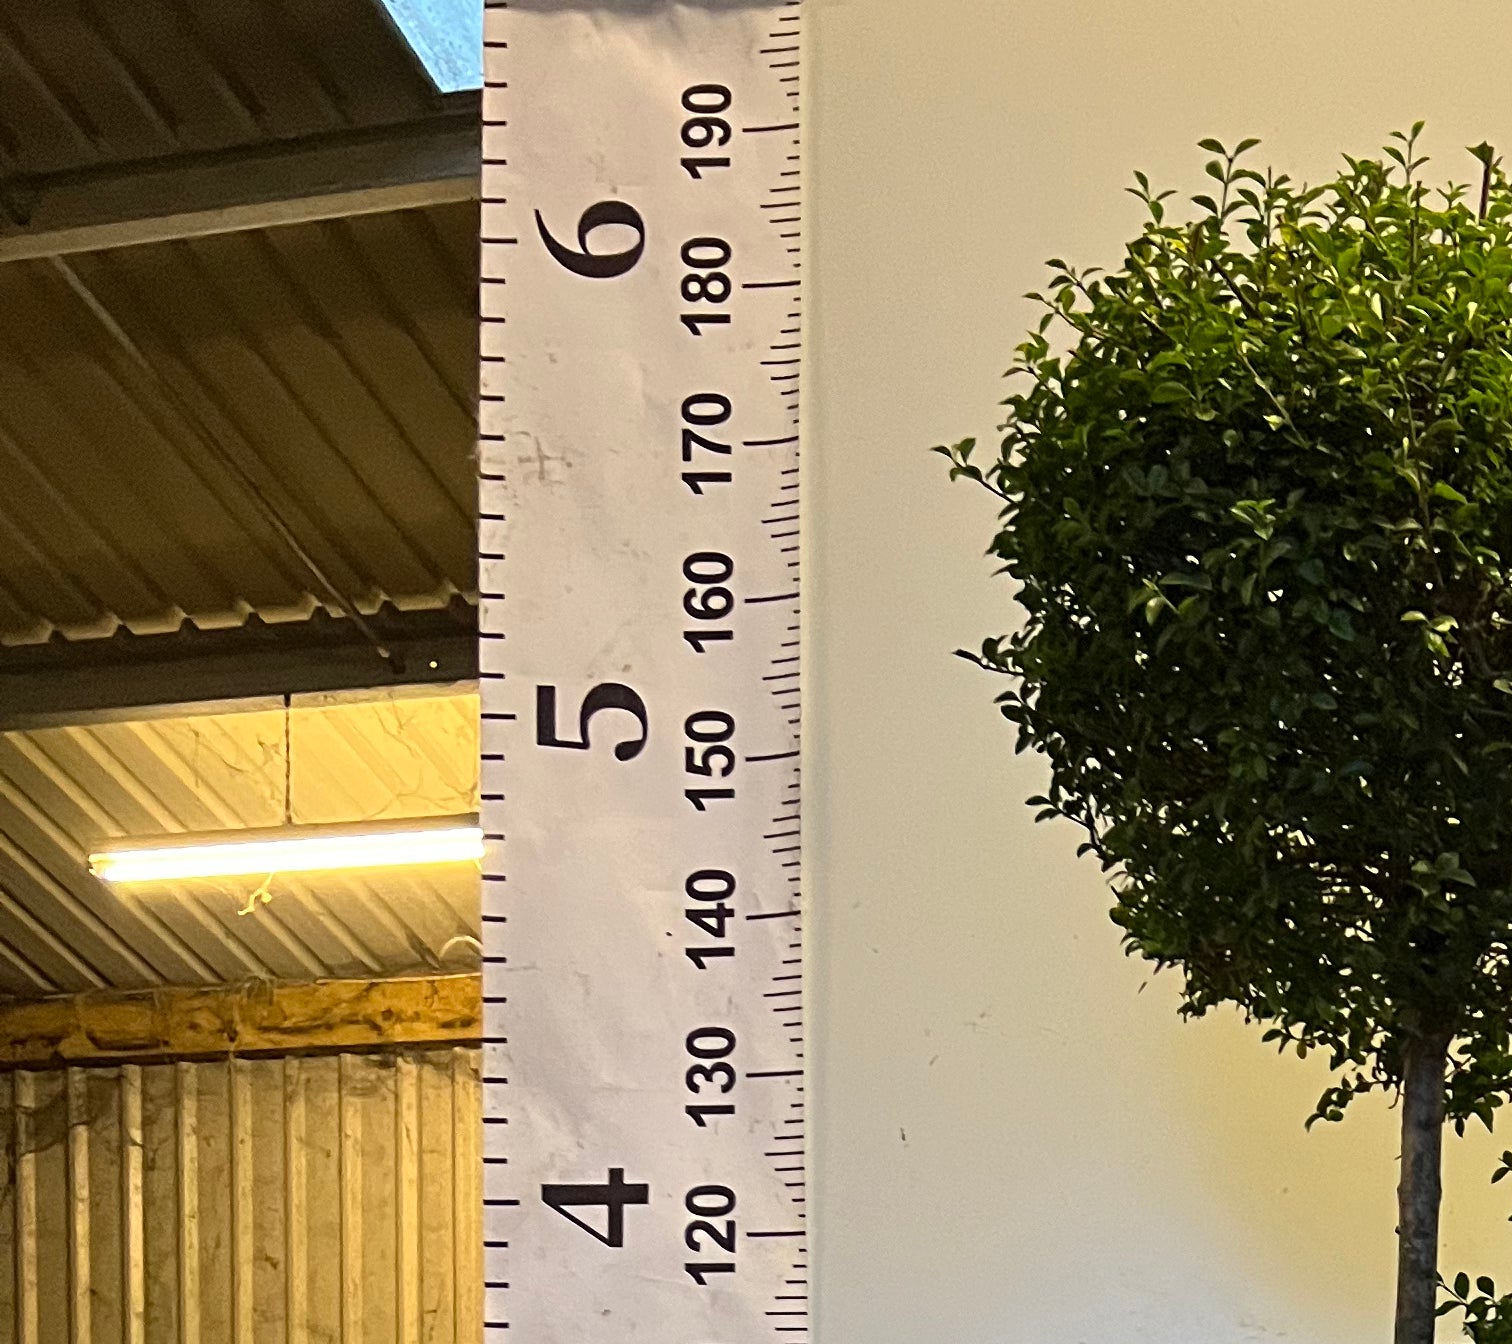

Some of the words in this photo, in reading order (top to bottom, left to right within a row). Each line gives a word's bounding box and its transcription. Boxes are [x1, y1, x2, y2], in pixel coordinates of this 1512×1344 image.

[681, 85, 731, 179] 190
[535, 201, 645, 278] 6
[680, 238, 731, 336] 180
[681, 394, 732, 494] 170
[683, 552, 733, 653] 160
[537, 683, 648, 761] 5
[685, 711, 735, 811] 150
[685, 870, 736, 969] 140
[685, 1027, 736, 1127] 130
[541, 1168, 649, 1247] 4
[685, 1185, 735, 1285] 120
